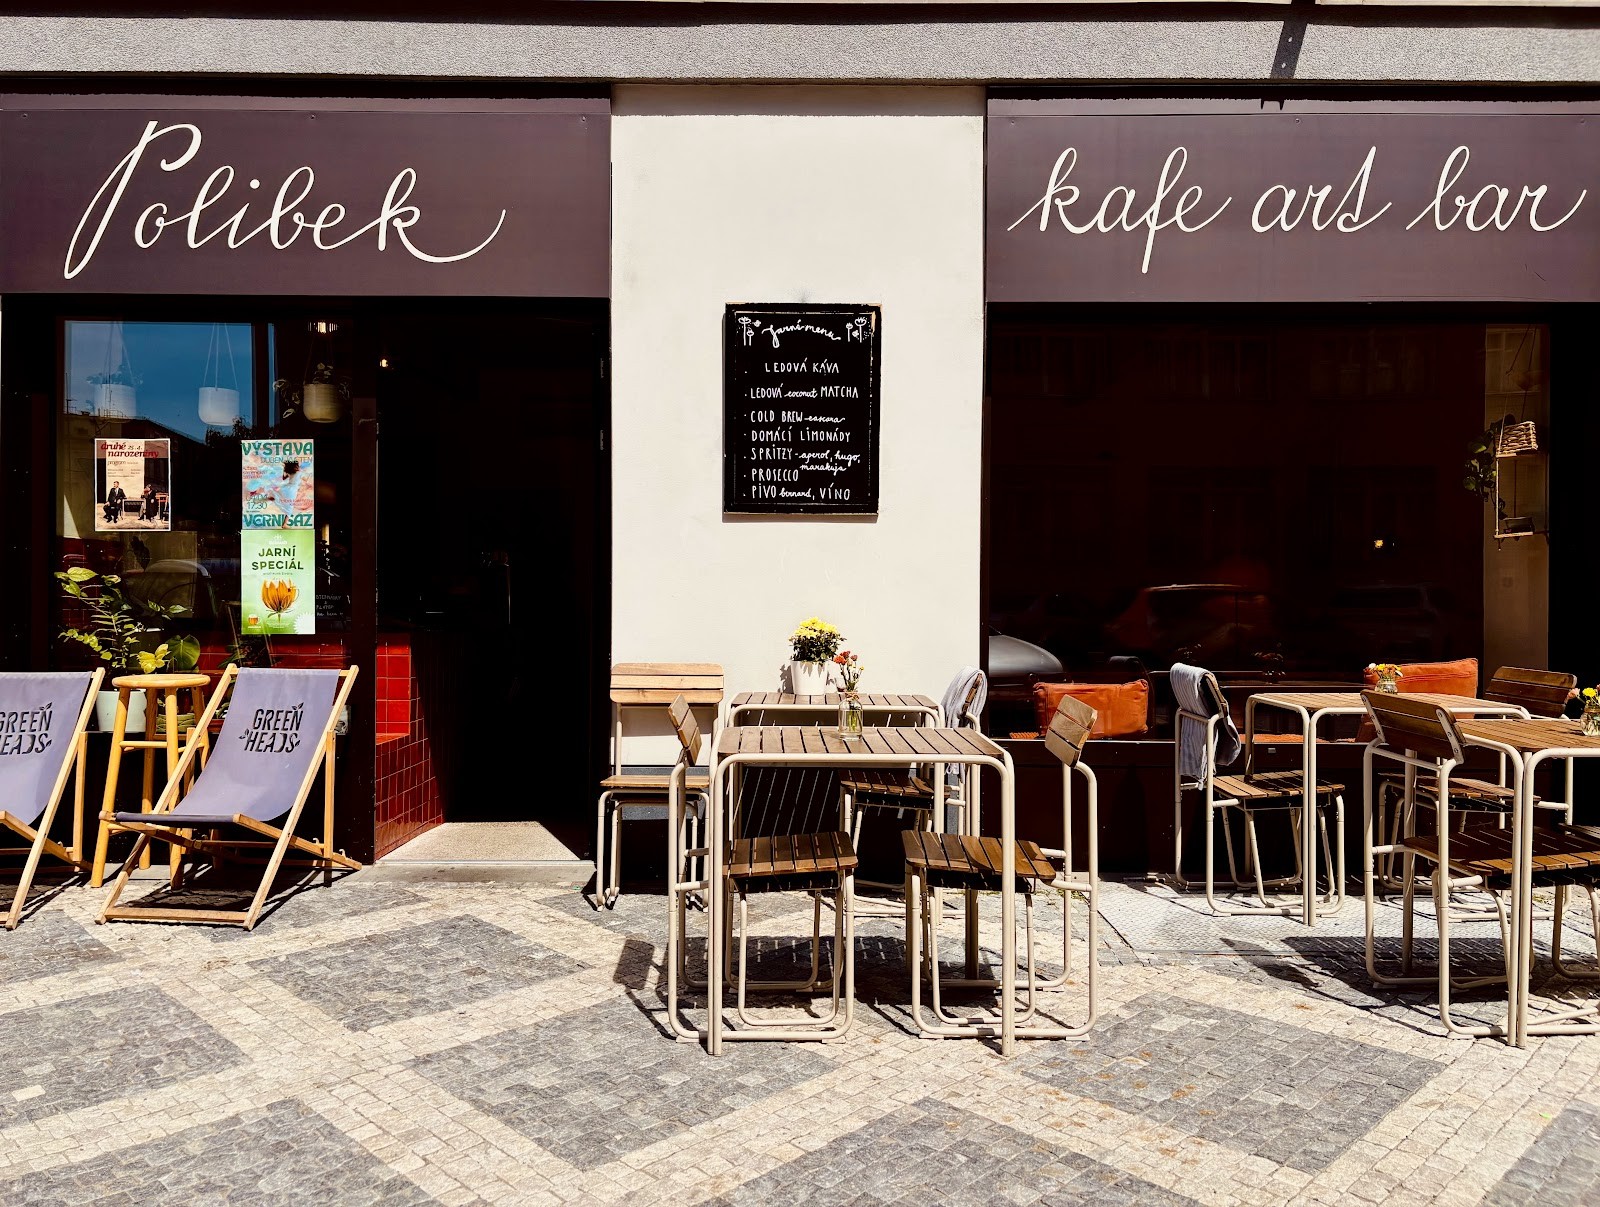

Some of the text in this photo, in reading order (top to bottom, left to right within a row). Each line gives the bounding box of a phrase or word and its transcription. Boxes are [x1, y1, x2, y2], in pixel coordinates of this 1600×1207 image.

[63, 120, 507, 280] Polibek
[1007, 147, 1233, 274] kafe
[1406, 146, 1587, 232] bar
[765, 357, 840, 374] LEDOVÁ KÁVA
[750, 382, 859, 399] LEDOVÁ coconut MATCHA
[750, 410, 775, 423] COLD
[781, 410, 803, 423] BREW
[751, 426, 793, 442] DOMÁCÍ
[108, 450, 159, 459] narozeniny
[751, 468, 799, 482] PROSECCO
[819, 482, 851, 501] VÍNO
[258, 545, 297, 557] JARNÍ
[251, 558, 304, 570] SPECIÁL
[252, 708, 304, 731] GREEN
